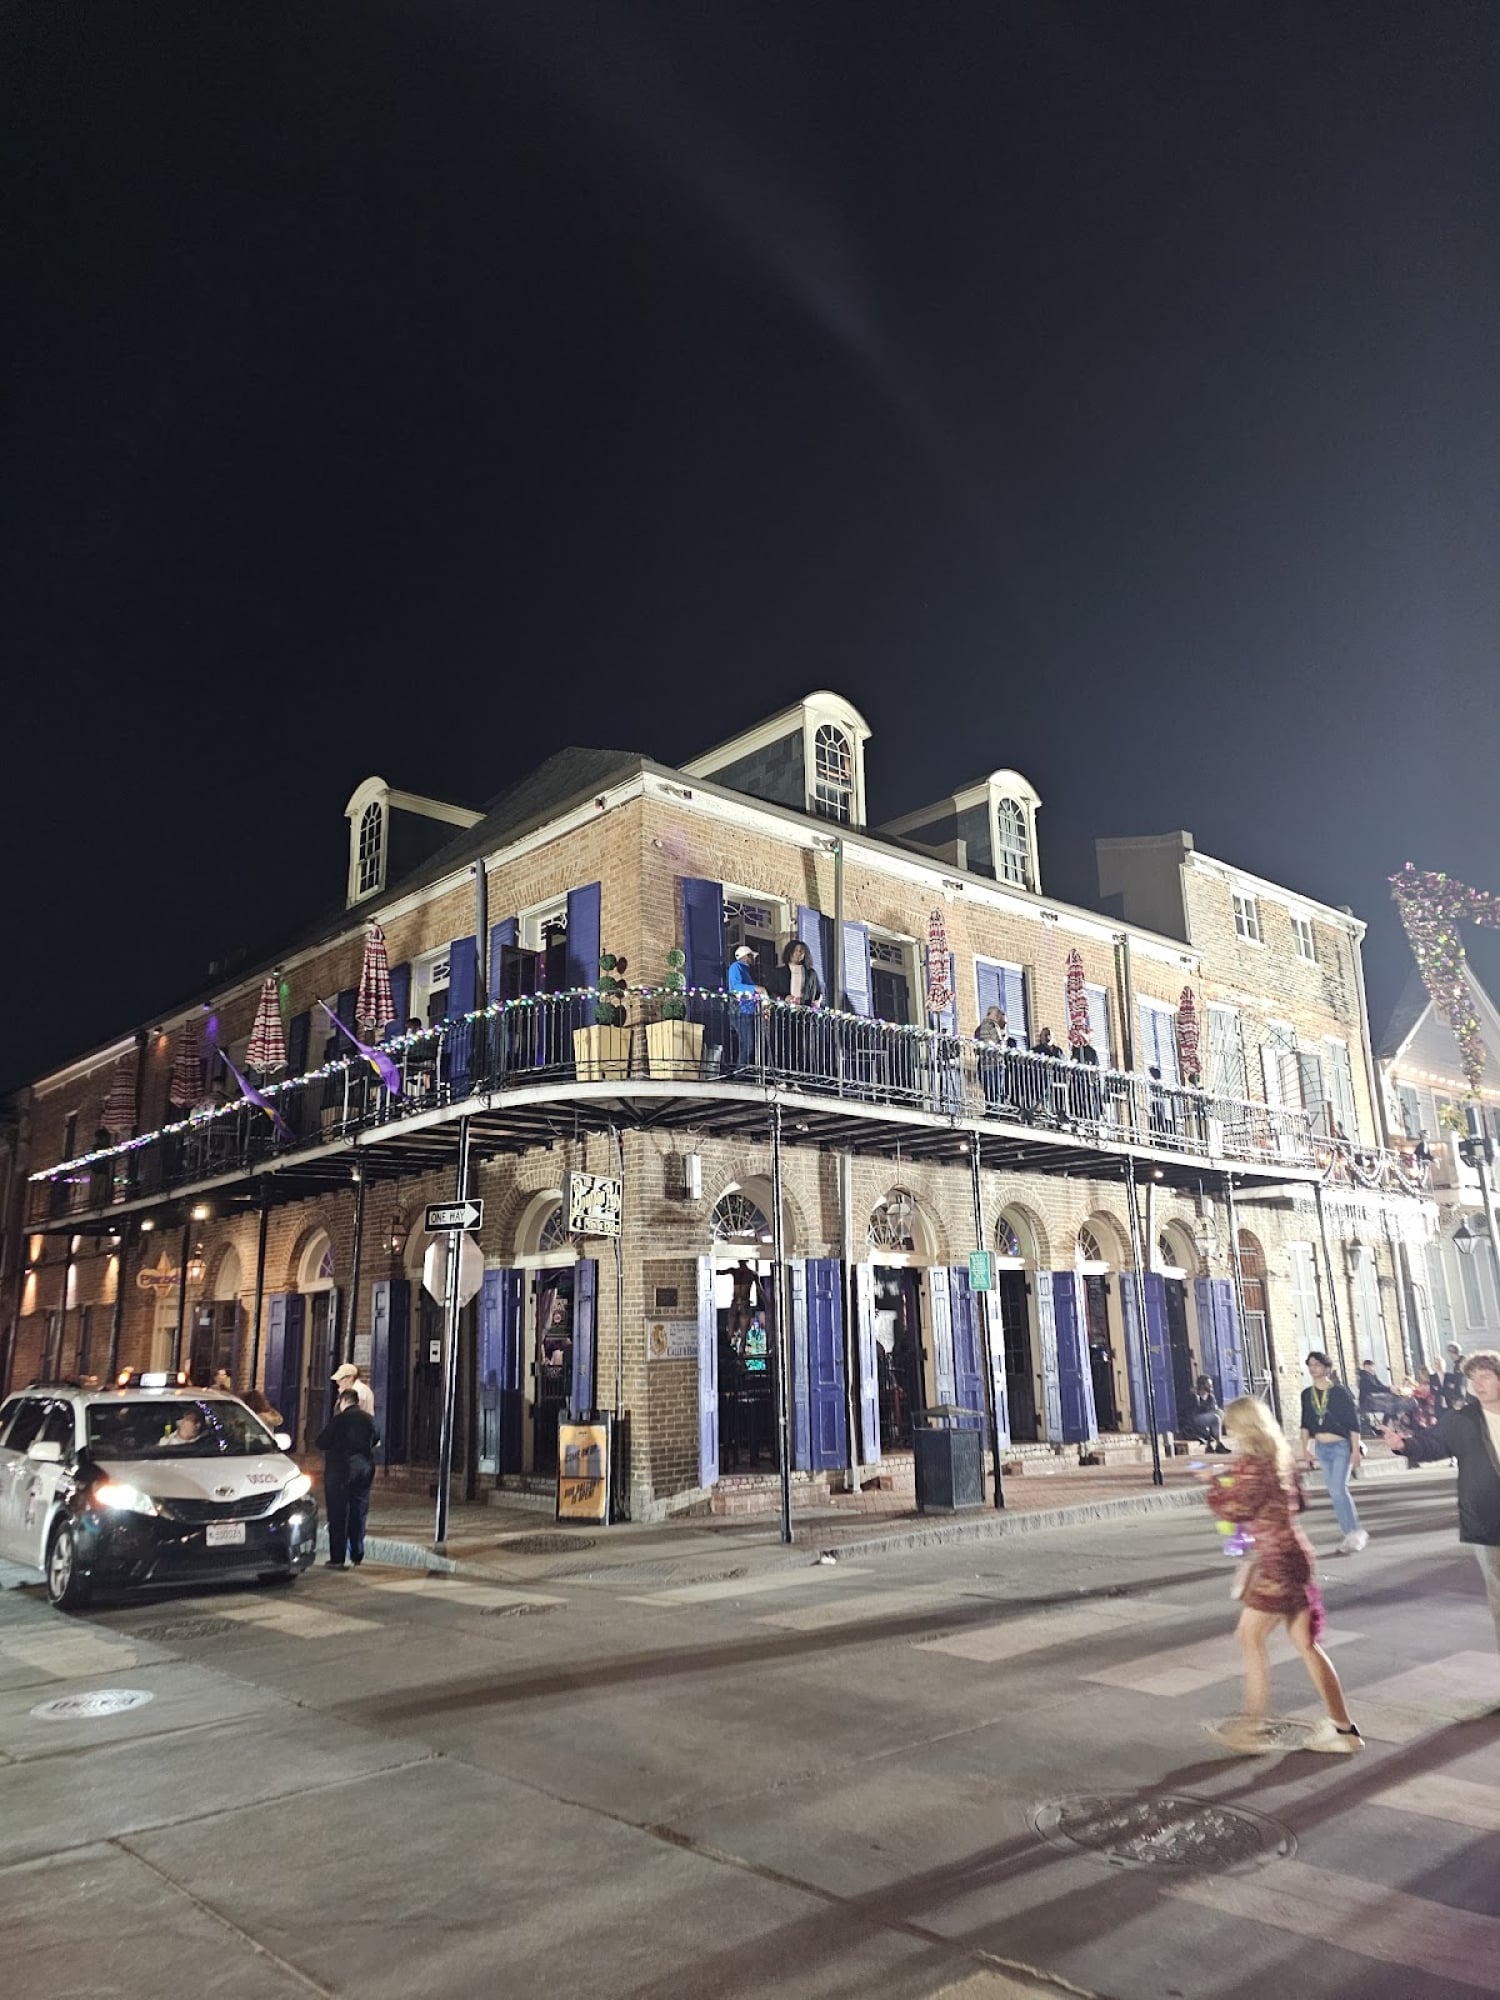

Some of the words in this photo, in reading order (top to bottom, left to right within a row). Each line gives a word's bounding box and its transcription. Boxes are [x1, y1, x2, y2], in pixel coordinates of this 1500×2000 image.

[430, 1211, 447, 1224] ONE
[450, 1209, 465, 1223] WAY
[140, 1273, 180, 1285] Parad
